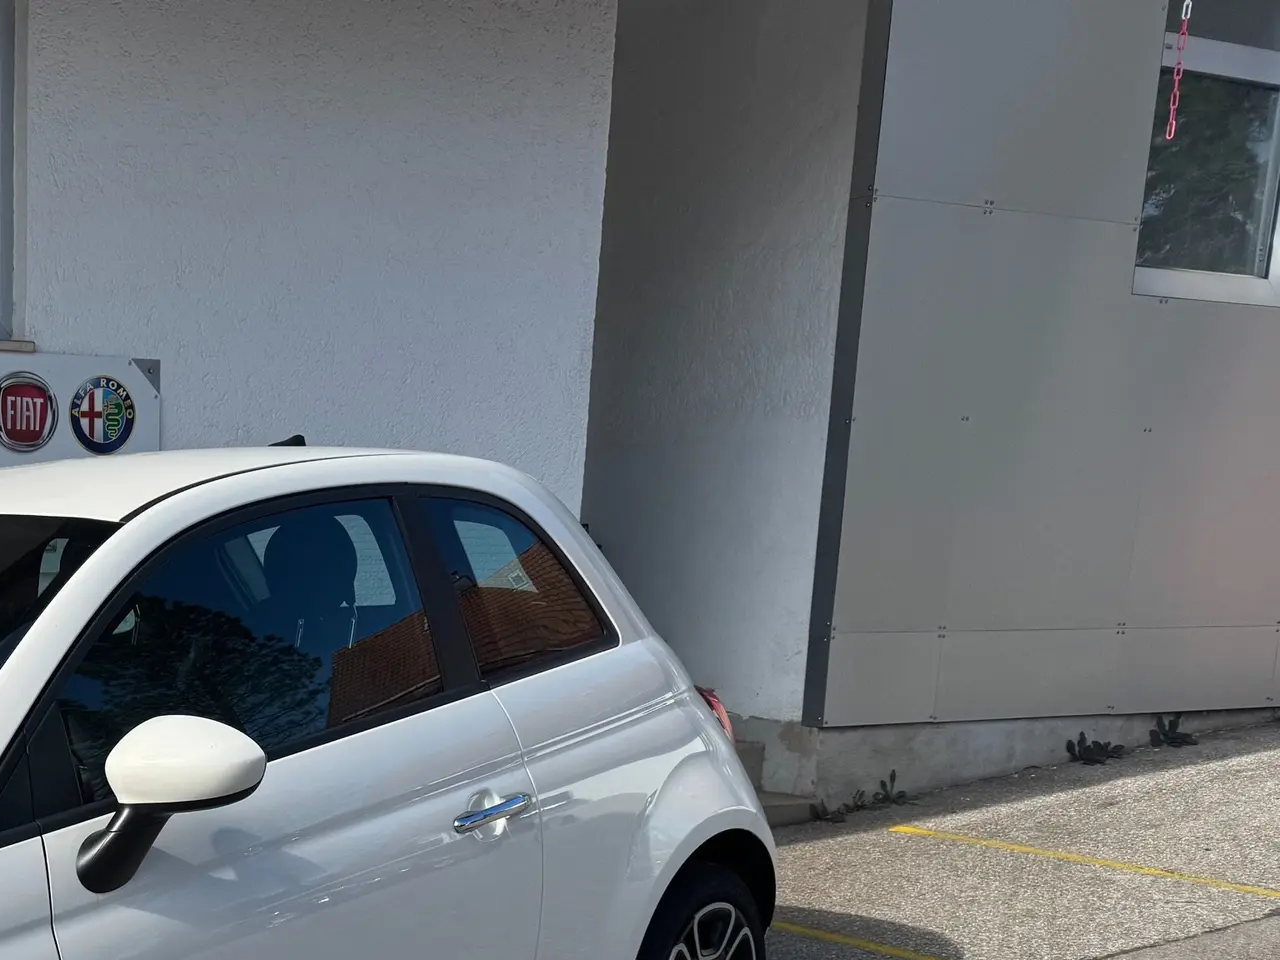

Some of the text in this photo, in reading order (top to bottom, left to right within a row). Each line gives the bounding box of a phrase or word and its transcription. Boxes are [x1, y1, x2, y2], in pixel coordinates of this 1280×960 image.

[6, 396, 44, 431] FIAT
[71, 378, 134, 419] ALFA ROMEO
